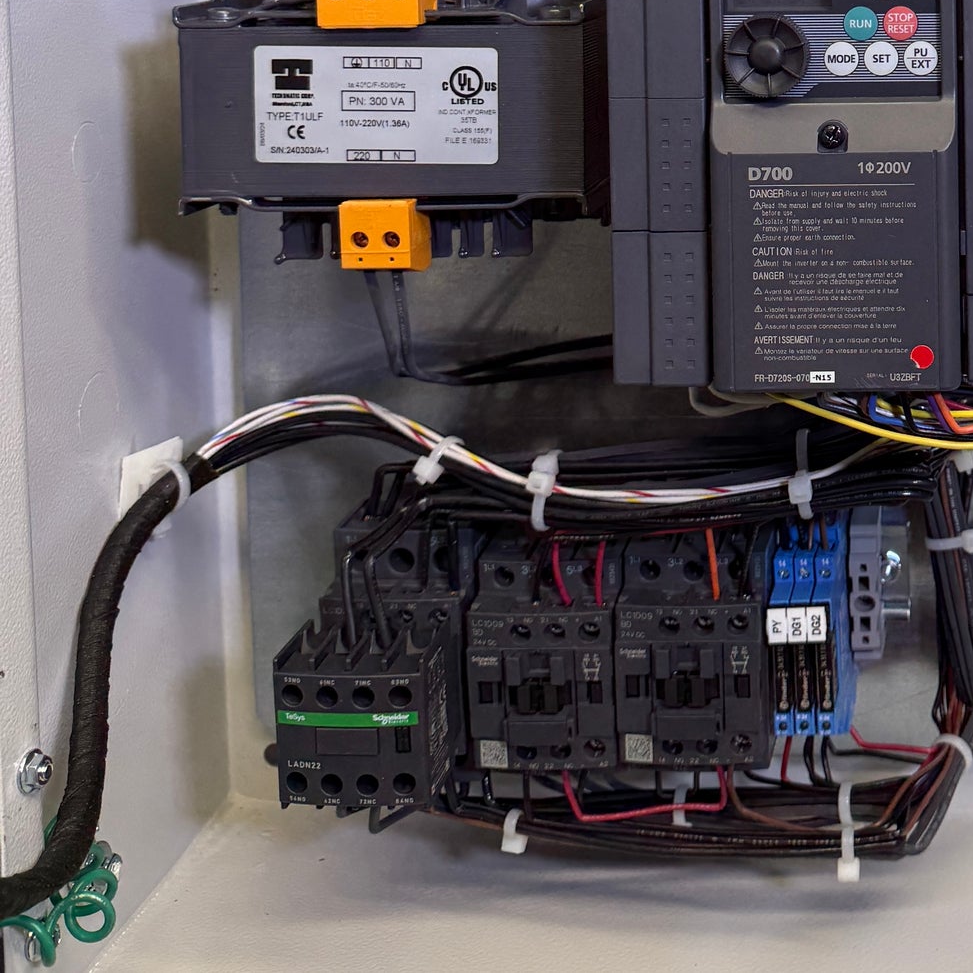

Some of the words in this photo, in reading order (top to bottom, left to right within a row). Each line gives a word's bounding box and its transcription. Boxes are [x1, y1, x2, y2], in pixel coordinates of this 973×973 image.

[888, 13, 913, 22] STOP
[850, 19, 872, 28] RUN
[888, 24, 914, 33] RESET
[914, 48, 928, 57] PU
[827, 55, 856, 63] MODE
[872, 54, 891, 63] SET
[912, 60, 931, 68] EXT
[349, 97, 367, 106] PN:
[369, 96, 387, 106] 300
[390, 97, 405, 106] VA
[353, 152, 370, 161] 220
[748, 167, 793, 181] D700
[752, 247, 792, 256] CAUTION
[753, 272, 784, 280] DANGER
[754, 335, 813, 344] AVERTISSEMENT
[773, 620, 782, 633] PY
[792, 616, 801, 636] DG1
[812, 614, 821, 635] DG2
[286, 713, 306, 721] TeSys
[372, 713, 410, 724] Schneider
[287, 760, 321, 769] LADN22
